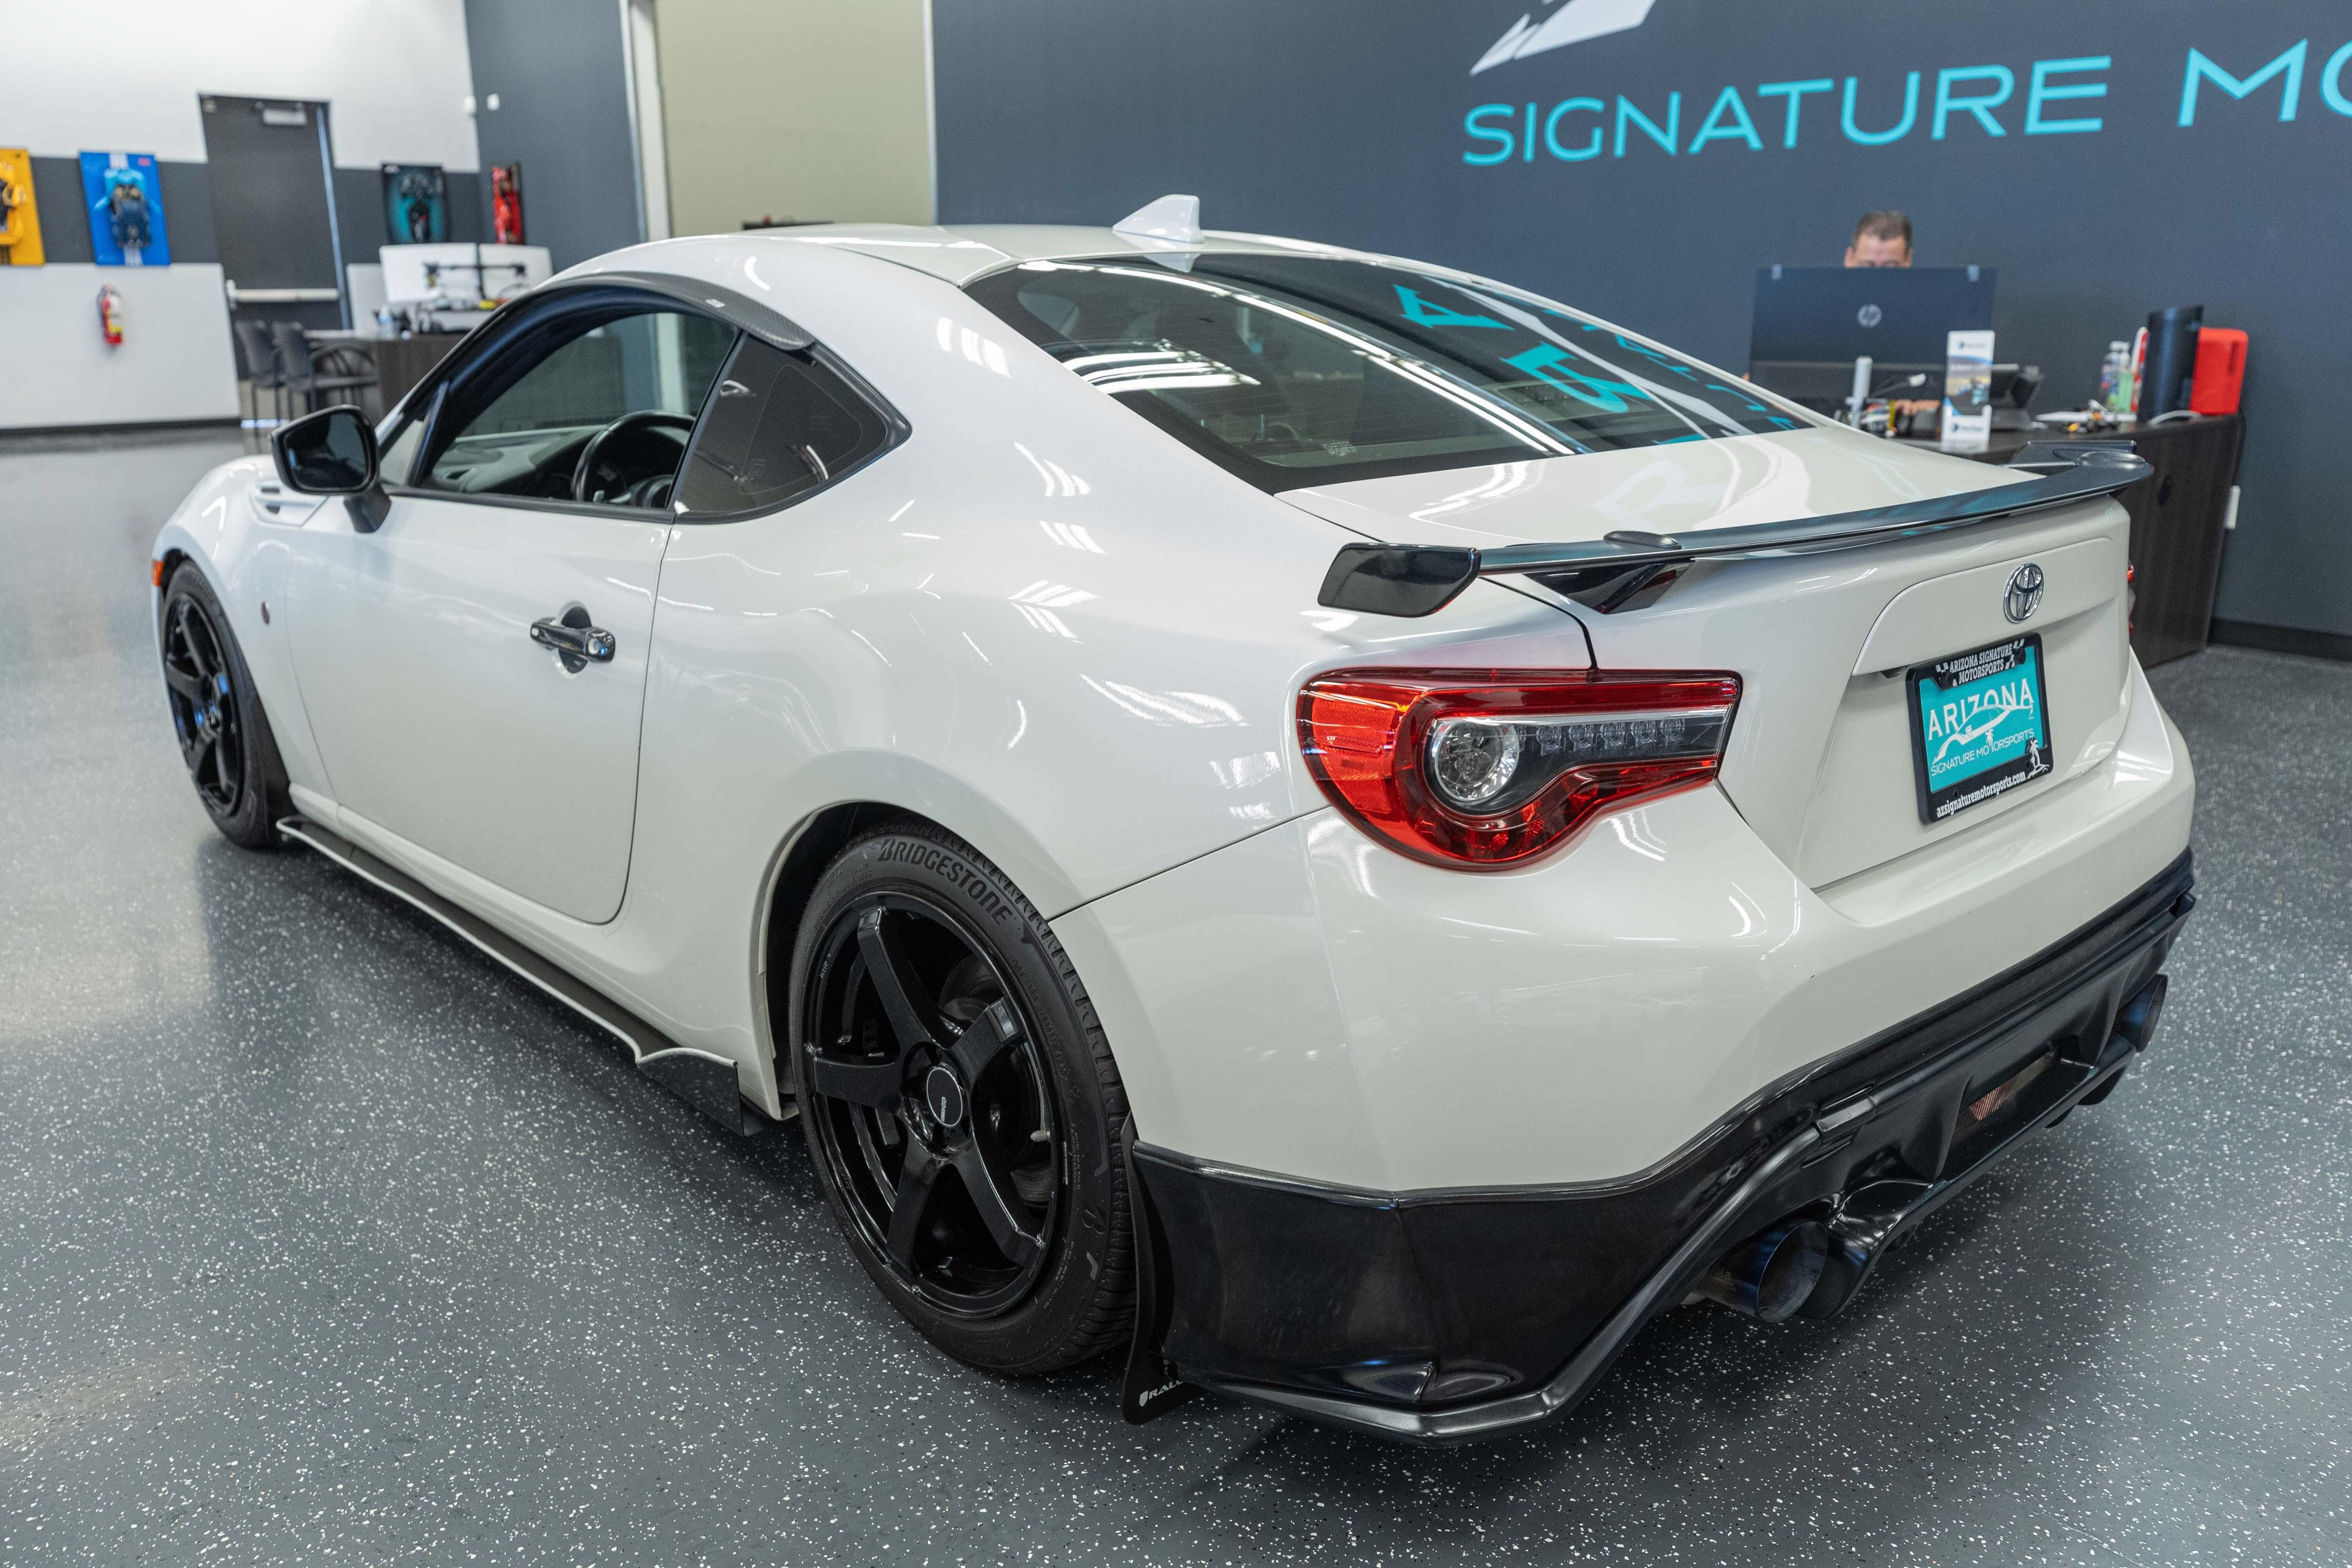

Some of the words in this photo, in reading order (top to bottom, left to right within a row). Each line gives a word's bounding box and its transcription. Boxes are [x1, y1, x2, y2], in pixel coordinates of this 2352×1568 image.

[1463, 55, 2111, 165] SIGNATURE
[1949, 654, 1978, 673] ARIZONA
[1979, 643, 2013, 664] SIGNATURE
[1959, 658, 2004, 685] MOTORSPORTS
[1928, 678, 2034, 741] ARIZONA
[1931, 751, 1976, 776] SIGNATURE
[1936, 771, 2026, 818] azsignaturemotorsports.com
[878, 838, 1013, 926] BRIDGESTONE
